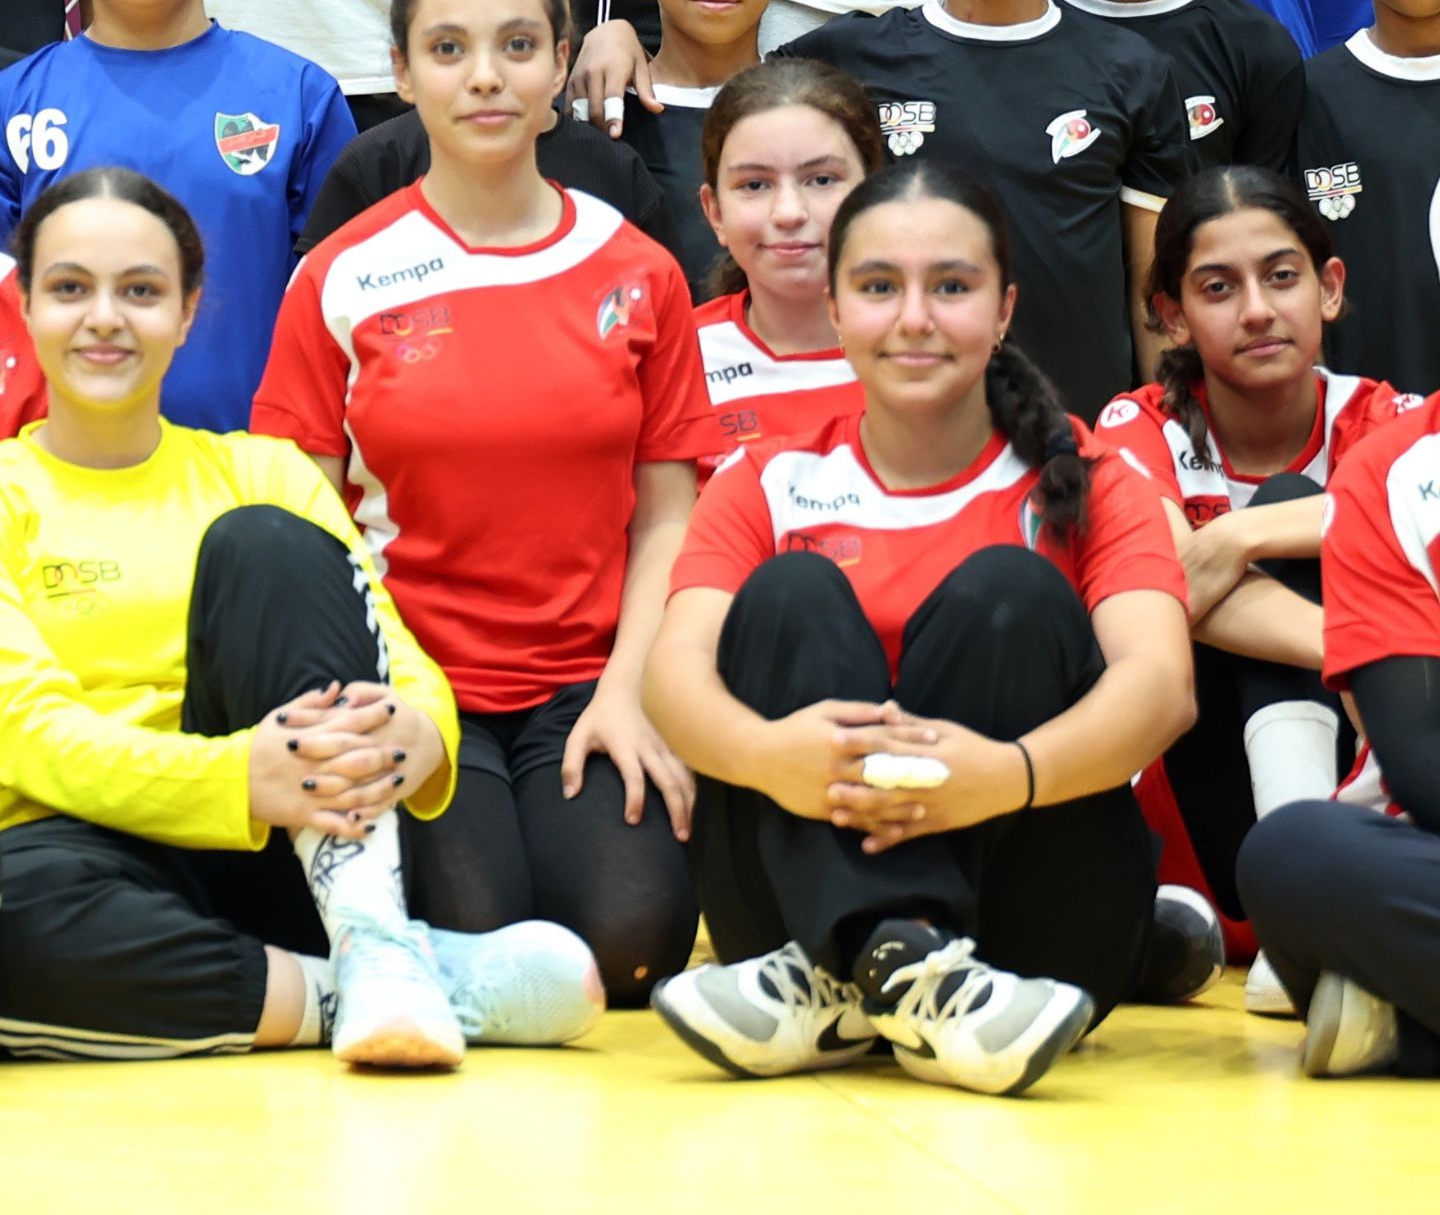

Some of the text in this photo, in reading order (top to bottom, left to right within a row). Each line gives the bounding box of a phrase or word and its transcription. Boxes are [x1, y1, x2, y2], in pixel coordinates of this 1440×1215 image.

[1303, 162, 1361, 190] DOSB
[356, 257, 444, 291] Kempa
[380, 306, 450, 335] DOSB
[706, 361, 753, 385] mpa
[719, 409, 757, 437] SB
[42, 560, 121, 589] DOSB
